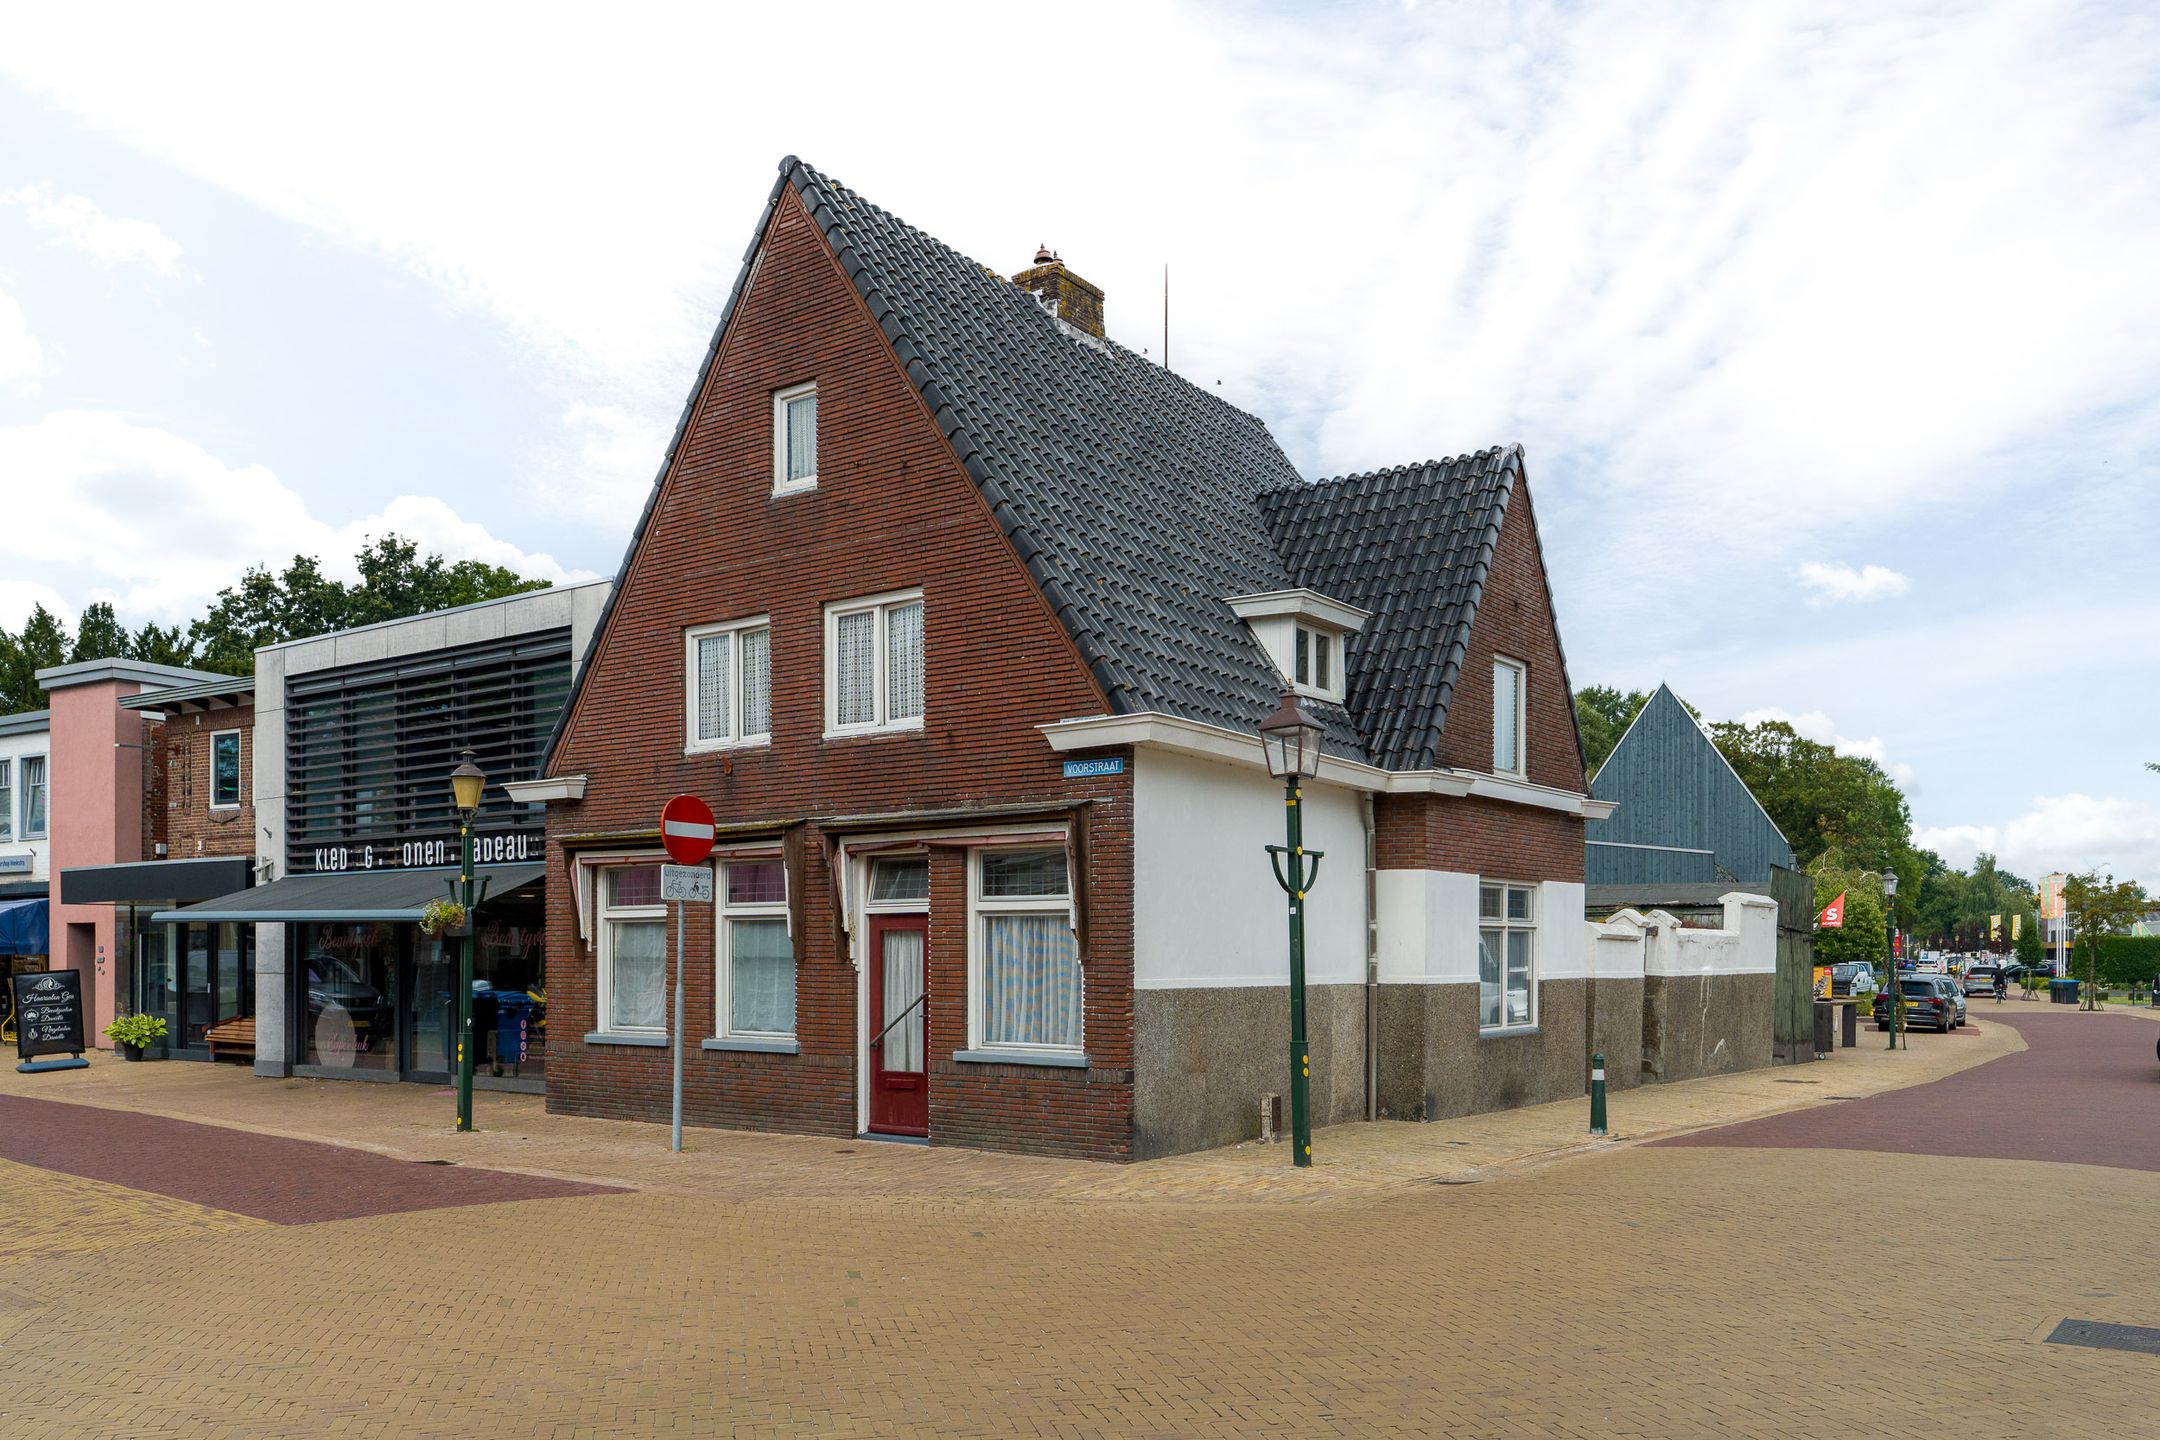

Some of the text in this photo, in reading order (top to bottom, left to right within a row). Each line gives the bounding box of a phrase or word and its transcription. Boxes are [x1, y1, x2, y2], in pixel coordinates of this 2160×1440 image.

[1067, 760, 1119, 774] VOORSTRAAT
[664, 868, 711, 880] uitgezonderd
[1826, 907, 1838, 921] S
